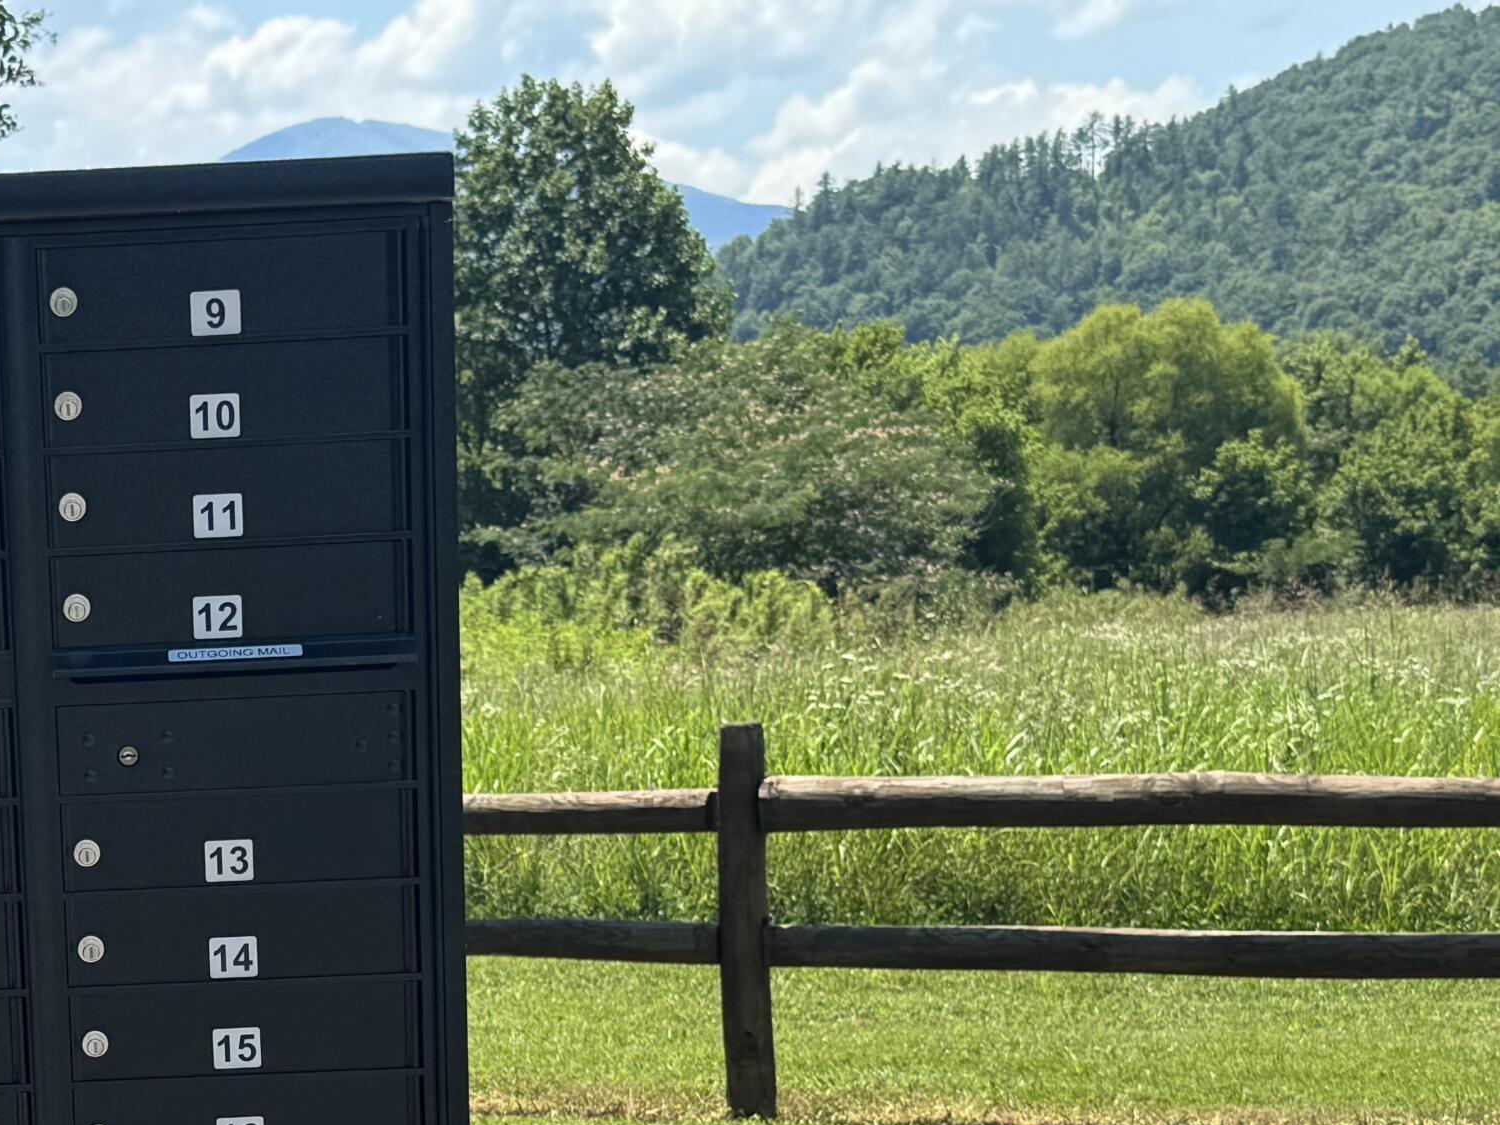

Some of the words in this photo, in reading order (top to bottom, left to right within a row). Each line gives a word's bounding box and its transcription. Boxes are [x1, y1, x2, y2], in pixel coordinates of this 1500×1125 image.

[206, 298, 225, 328] 9
[196, 400, 234, 431] 10
[201, 501, 235, 531] 11
[198, 602, 237, 631] 12
[177, 648, 254, 659] OUTGOING
[257, 646, 291, 657] MAIL
[210, 846, 248, 875] 13
[214, 943, 253, 972] 14
[218, 1034, 256, 1062] 15
